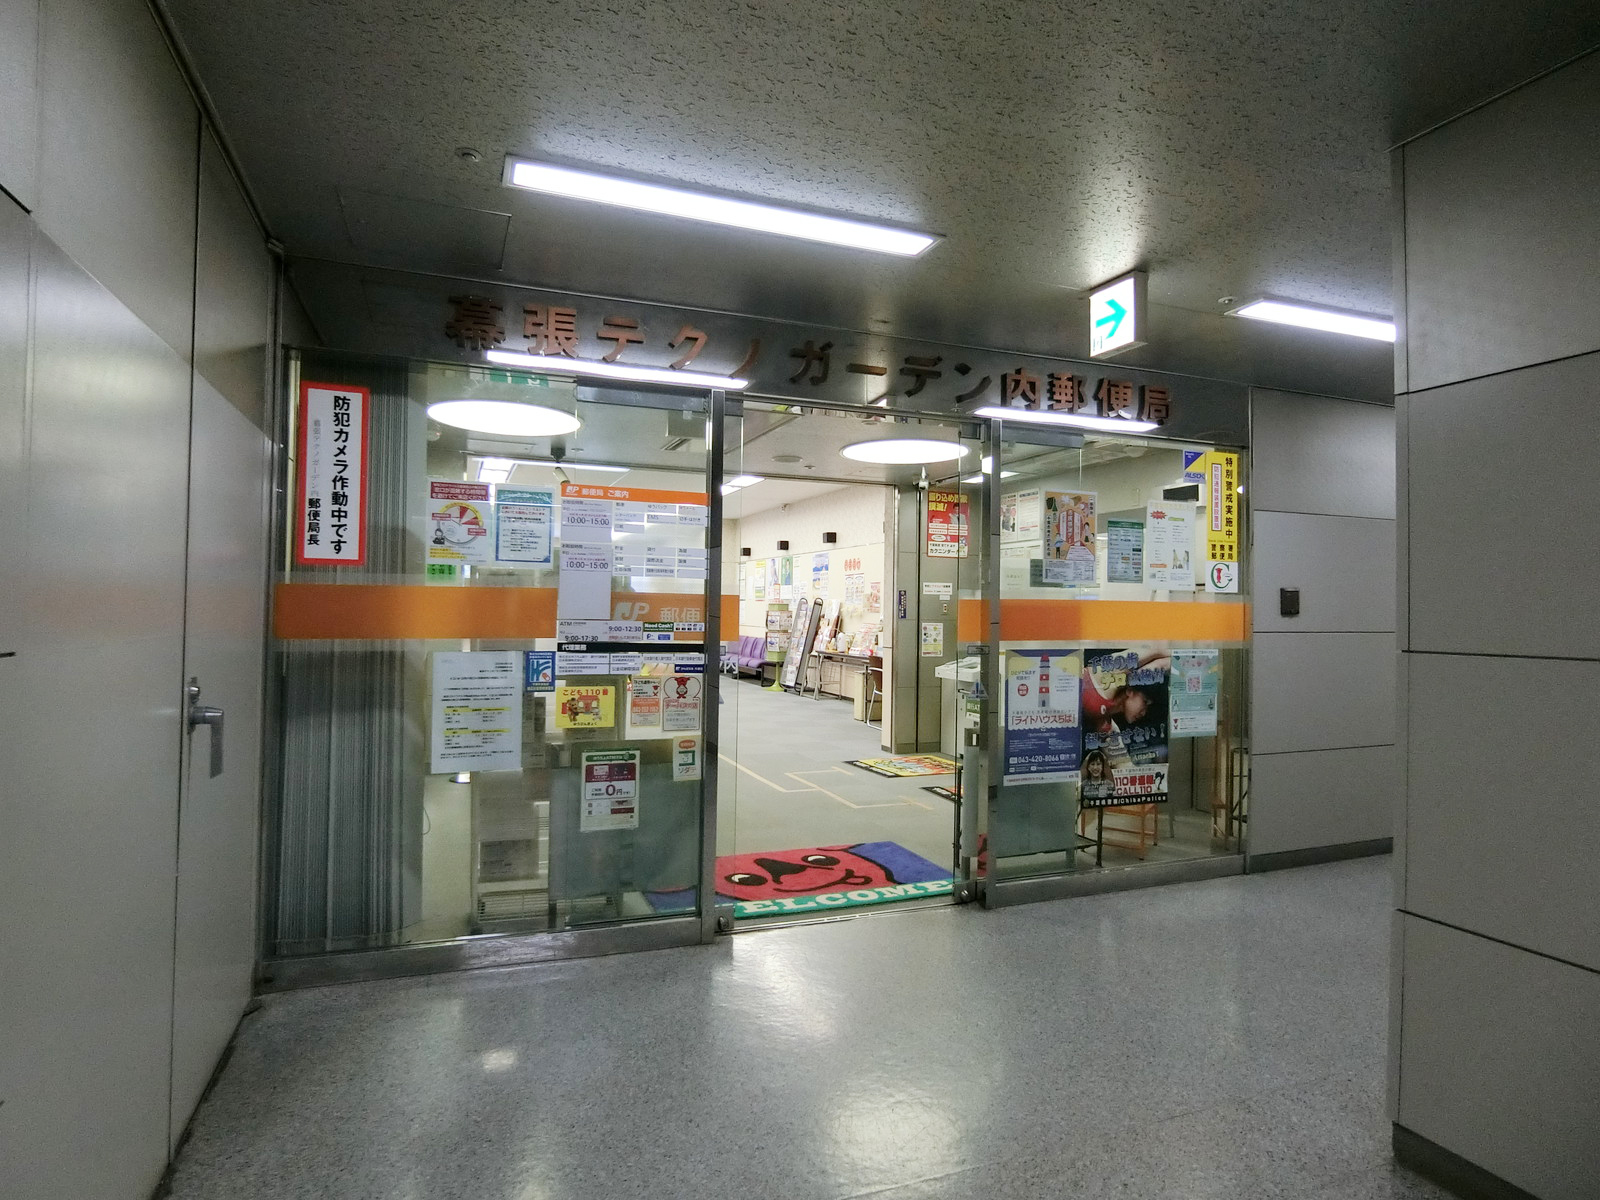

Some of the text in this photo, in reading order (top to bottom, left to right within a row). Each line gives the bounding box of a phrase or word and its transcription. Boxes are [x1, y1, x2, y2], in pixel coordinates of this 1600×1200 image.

[446, 296, 1171, 421] 幕張テクノガーデン内郵便局
[331, 396, 351, 554] 防犯カメラ作動中です
[582, 488, 604, 496] 郵便局
[608, 490, 629, 498] ご案内
[1225, 457, 1233, 539] 特別警戒実施中
[307, 498, 321, 546] 郵便局長
[660, 607, 701, 622] 郵便
[1018, 754, 1059, 763] 043-420-8066
